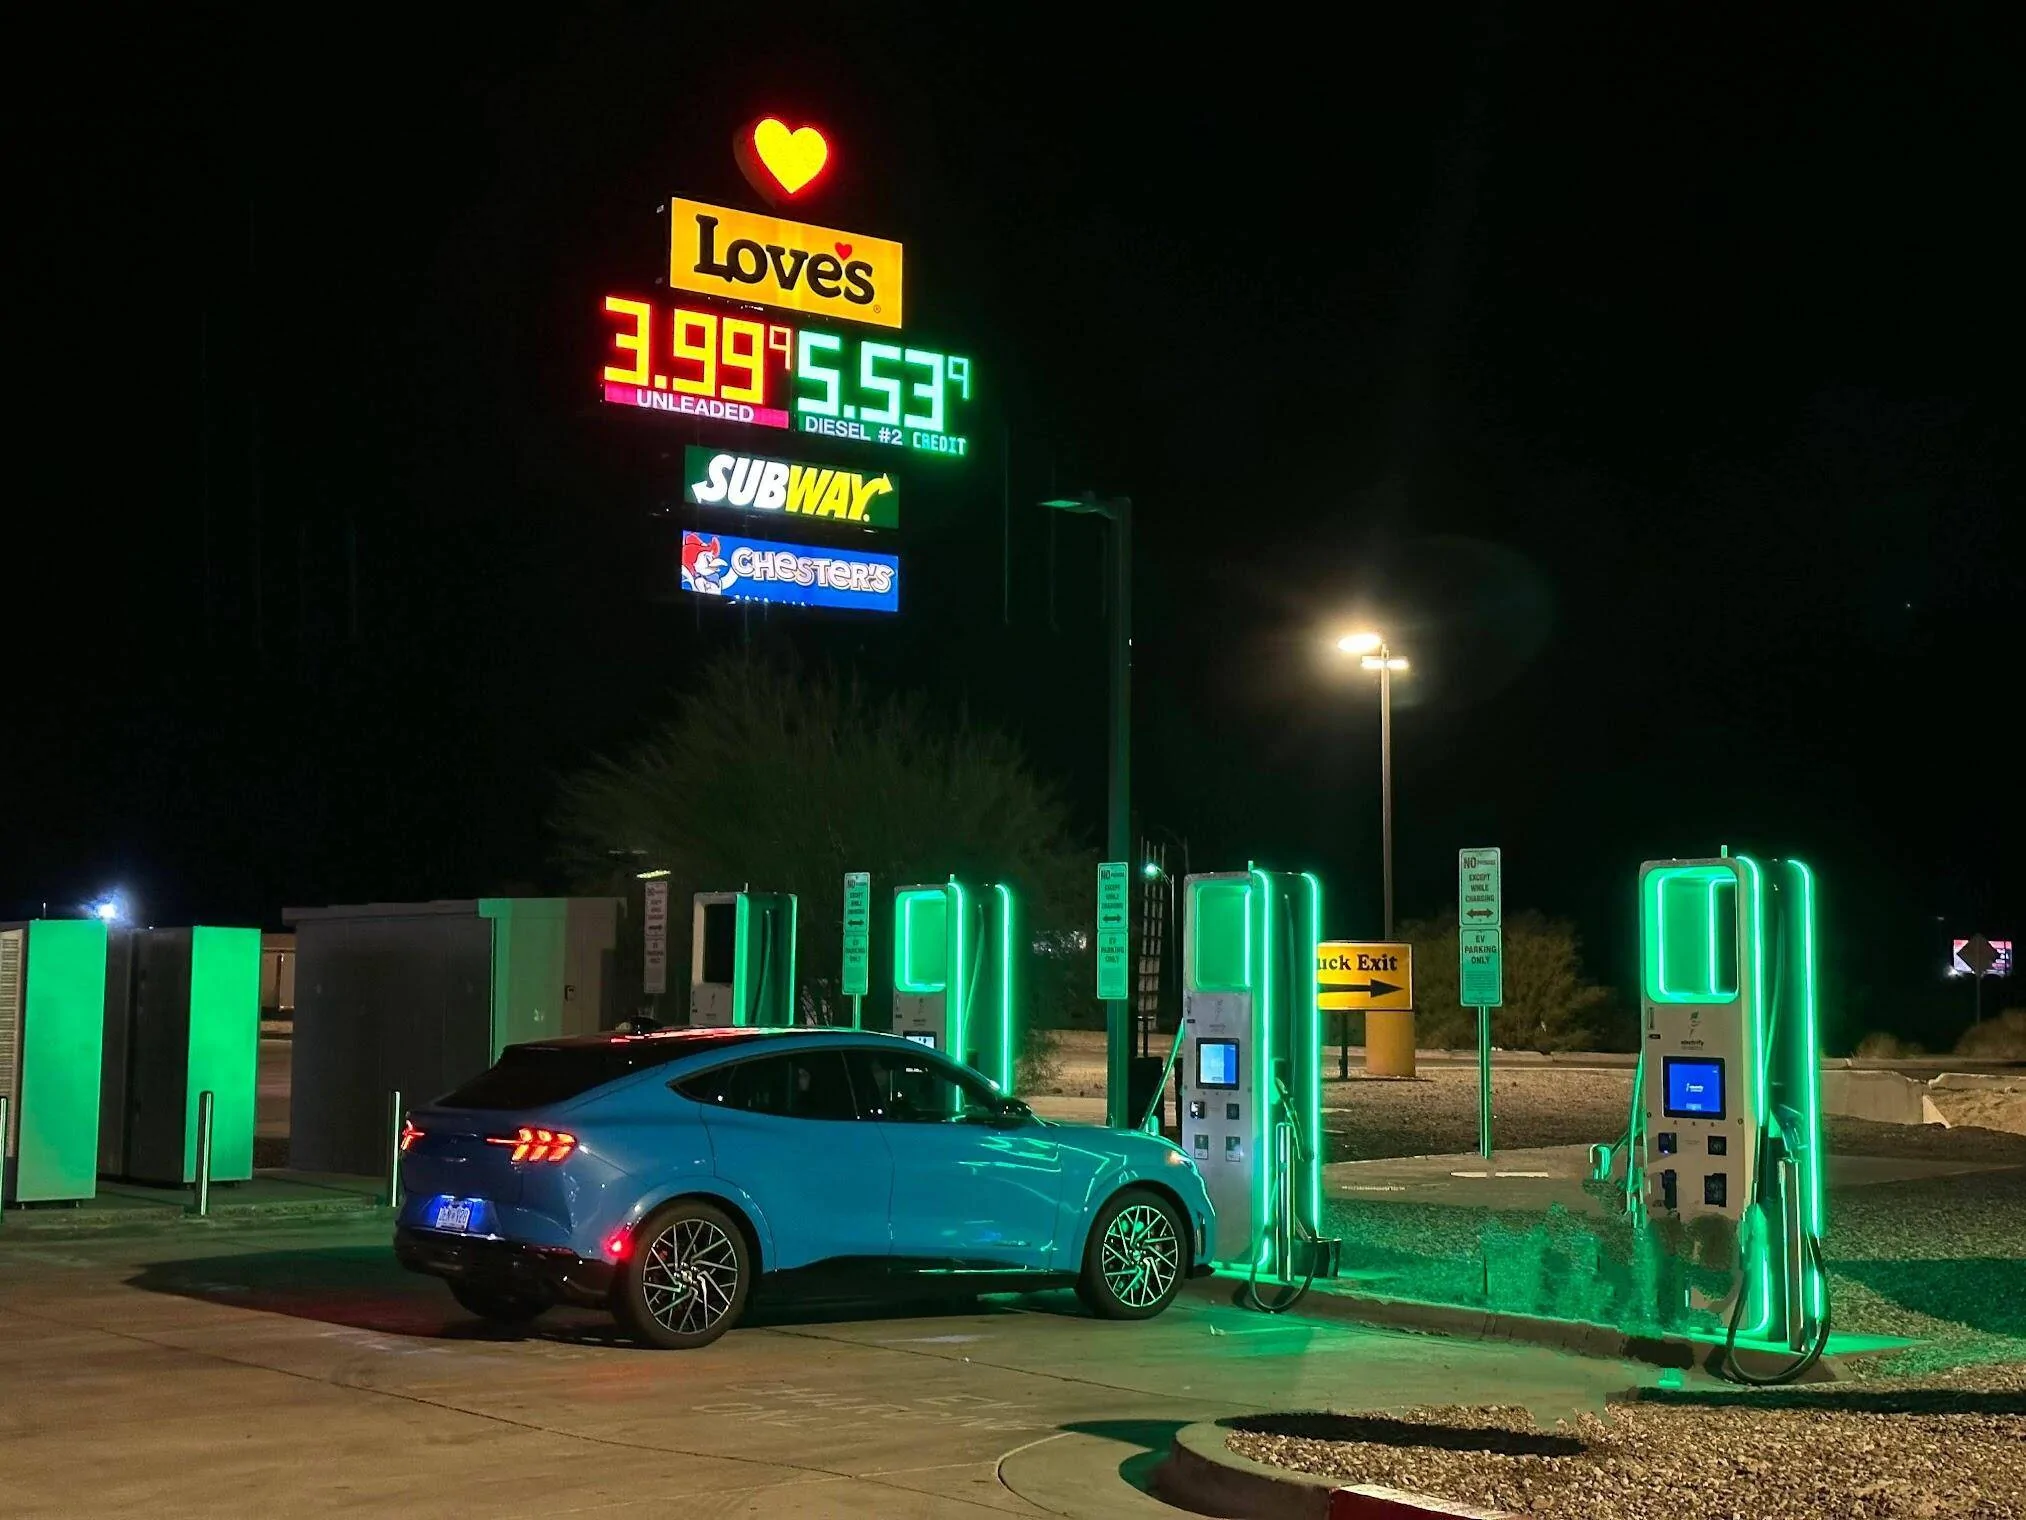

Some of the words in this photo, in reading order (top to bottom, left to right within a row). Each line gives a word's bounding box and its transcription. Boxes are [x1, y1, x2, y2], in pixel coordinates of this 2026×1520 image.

[636, 387, 755, 424] UNLEADED
[804, 416, 872, 443] DIESEL
[877, 427, 904, 447] #2
[912, 431, 967, 456] CREDIT
[691, 453, 894, 522] SUBWAY
[1463, 857, 1477, 869] NO
[1475, 935, 1486, 943] EV
[1464, 945, 1497, 954] PARKING
[1317, 954, 1351, 971] uck
[1357, 953, 1398, 971] Exit
[1471, 956, 1491, 965] ONLY
